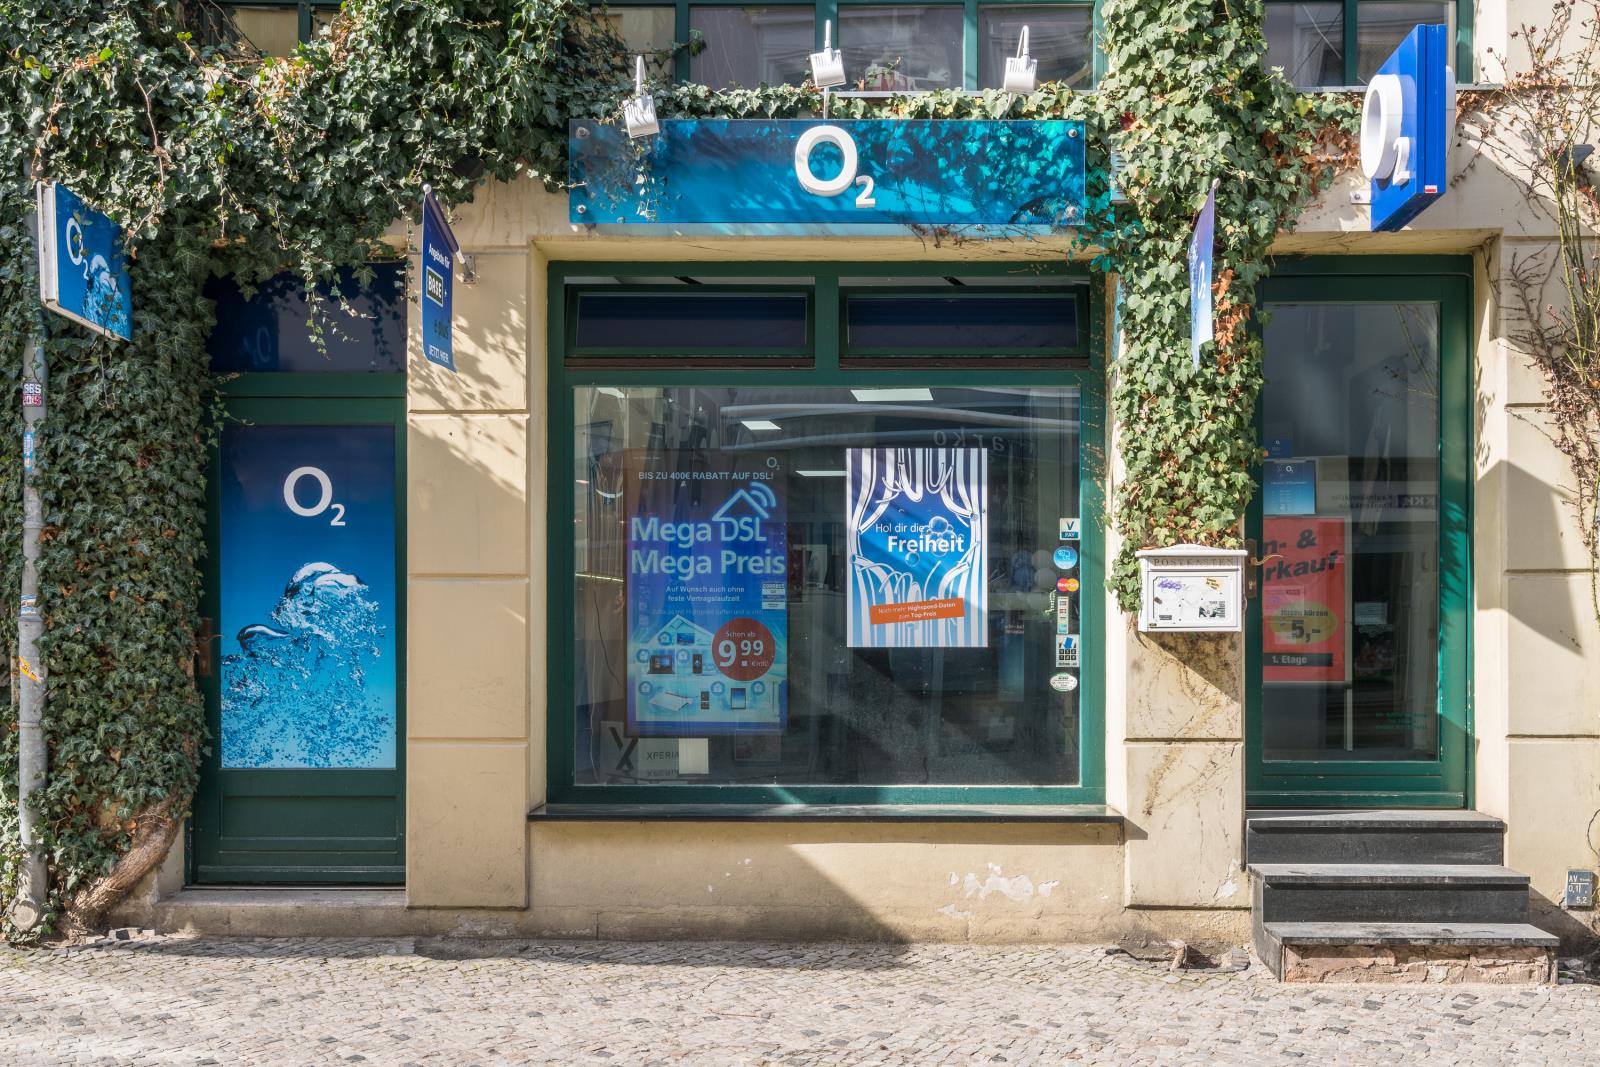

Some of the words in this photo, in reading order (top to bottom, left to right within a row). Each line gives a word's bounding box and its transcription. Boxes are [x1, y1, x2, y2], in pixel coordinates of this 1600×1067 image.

[1360, 73, 1411, 187] O2
[795, 125, 876, 208] O2
[428, 274, 442, 299] BASE
[655, 471, 668, 480] ZU
[669, 471, 691, 480] 400€
[692, 471, 730, 480] RABATT
[731, 471, 750, 480] AUF
[752, 471, 774, 480] DSL!
[283, 465, 346, 526] O2
[631, 517, 712, 548] Mega
[720, 516, 767, 542] DSL
[875, 523, 892, 533] Hol
[894, 523, 908, 533] dir
[910, 523, 925, 533] die
[1262, 540, 1287, 554] n-
[1296, 528, 1318, 549] &
[887, 534, 965, 553] Freiheit
[631, 549, 712, 581] Mega
[720, 549, 786, 574] Preis
[1262, 549, 1339, 581] rkauf
[665, 585, 679, 593] Auf
[679, 585, 708, 593] Wunsch
[709, 585, 726, 593] auch
[727, 585, 745, 593] ohne
[1281, 655, 1308, 666] Etage
